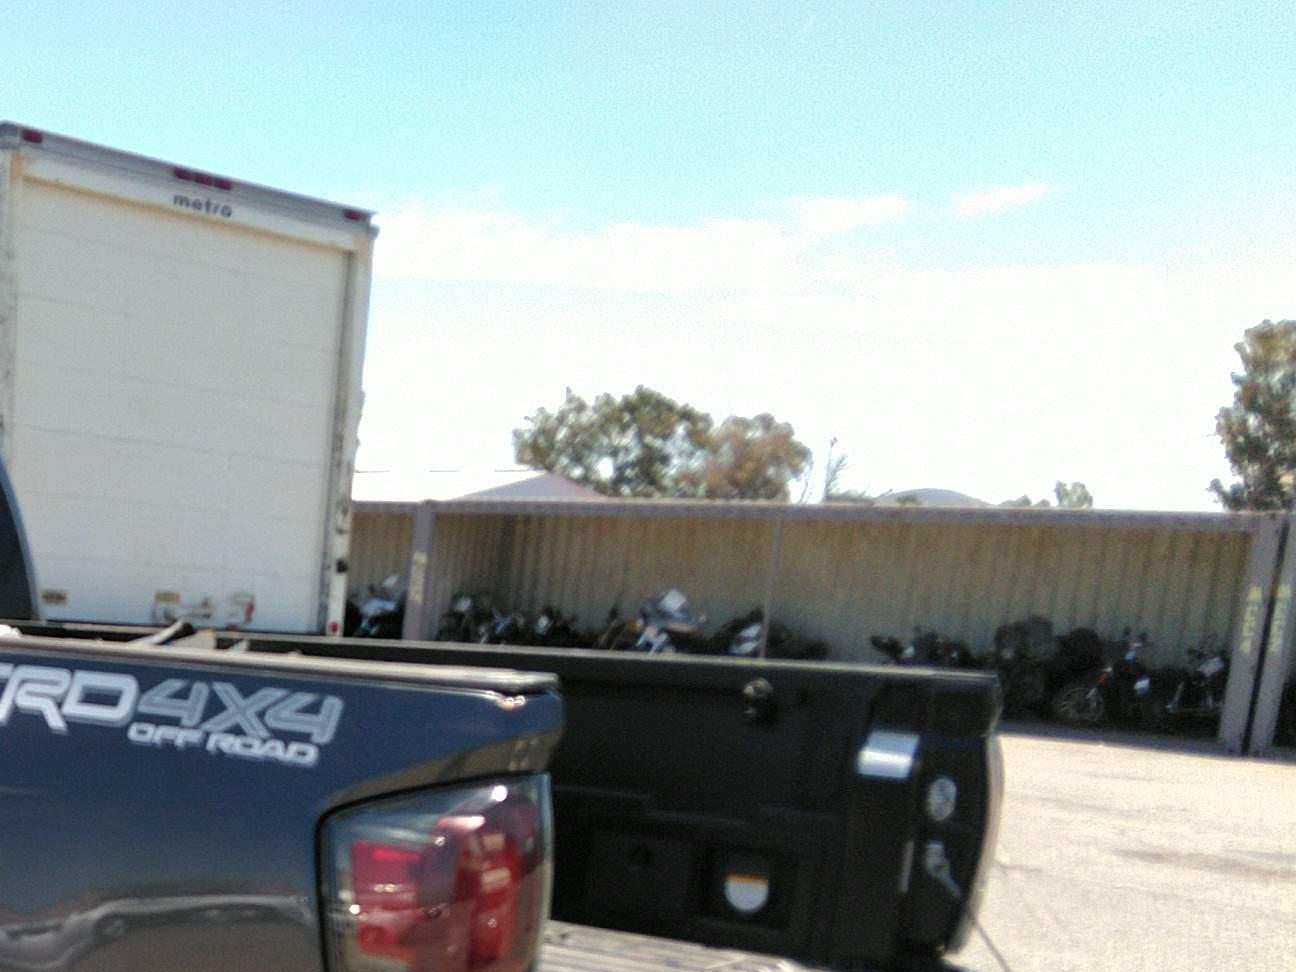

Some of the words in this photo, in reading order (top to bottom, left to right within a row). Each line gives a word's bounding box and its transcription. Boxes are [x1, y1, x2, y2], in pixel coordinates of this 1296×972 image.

[173, 194, 233, 218] metro
[138, 678, 343, 745] 4X4
[128, 722, 202, 750] OFF
[206, 734, 320, 767] ROAD
